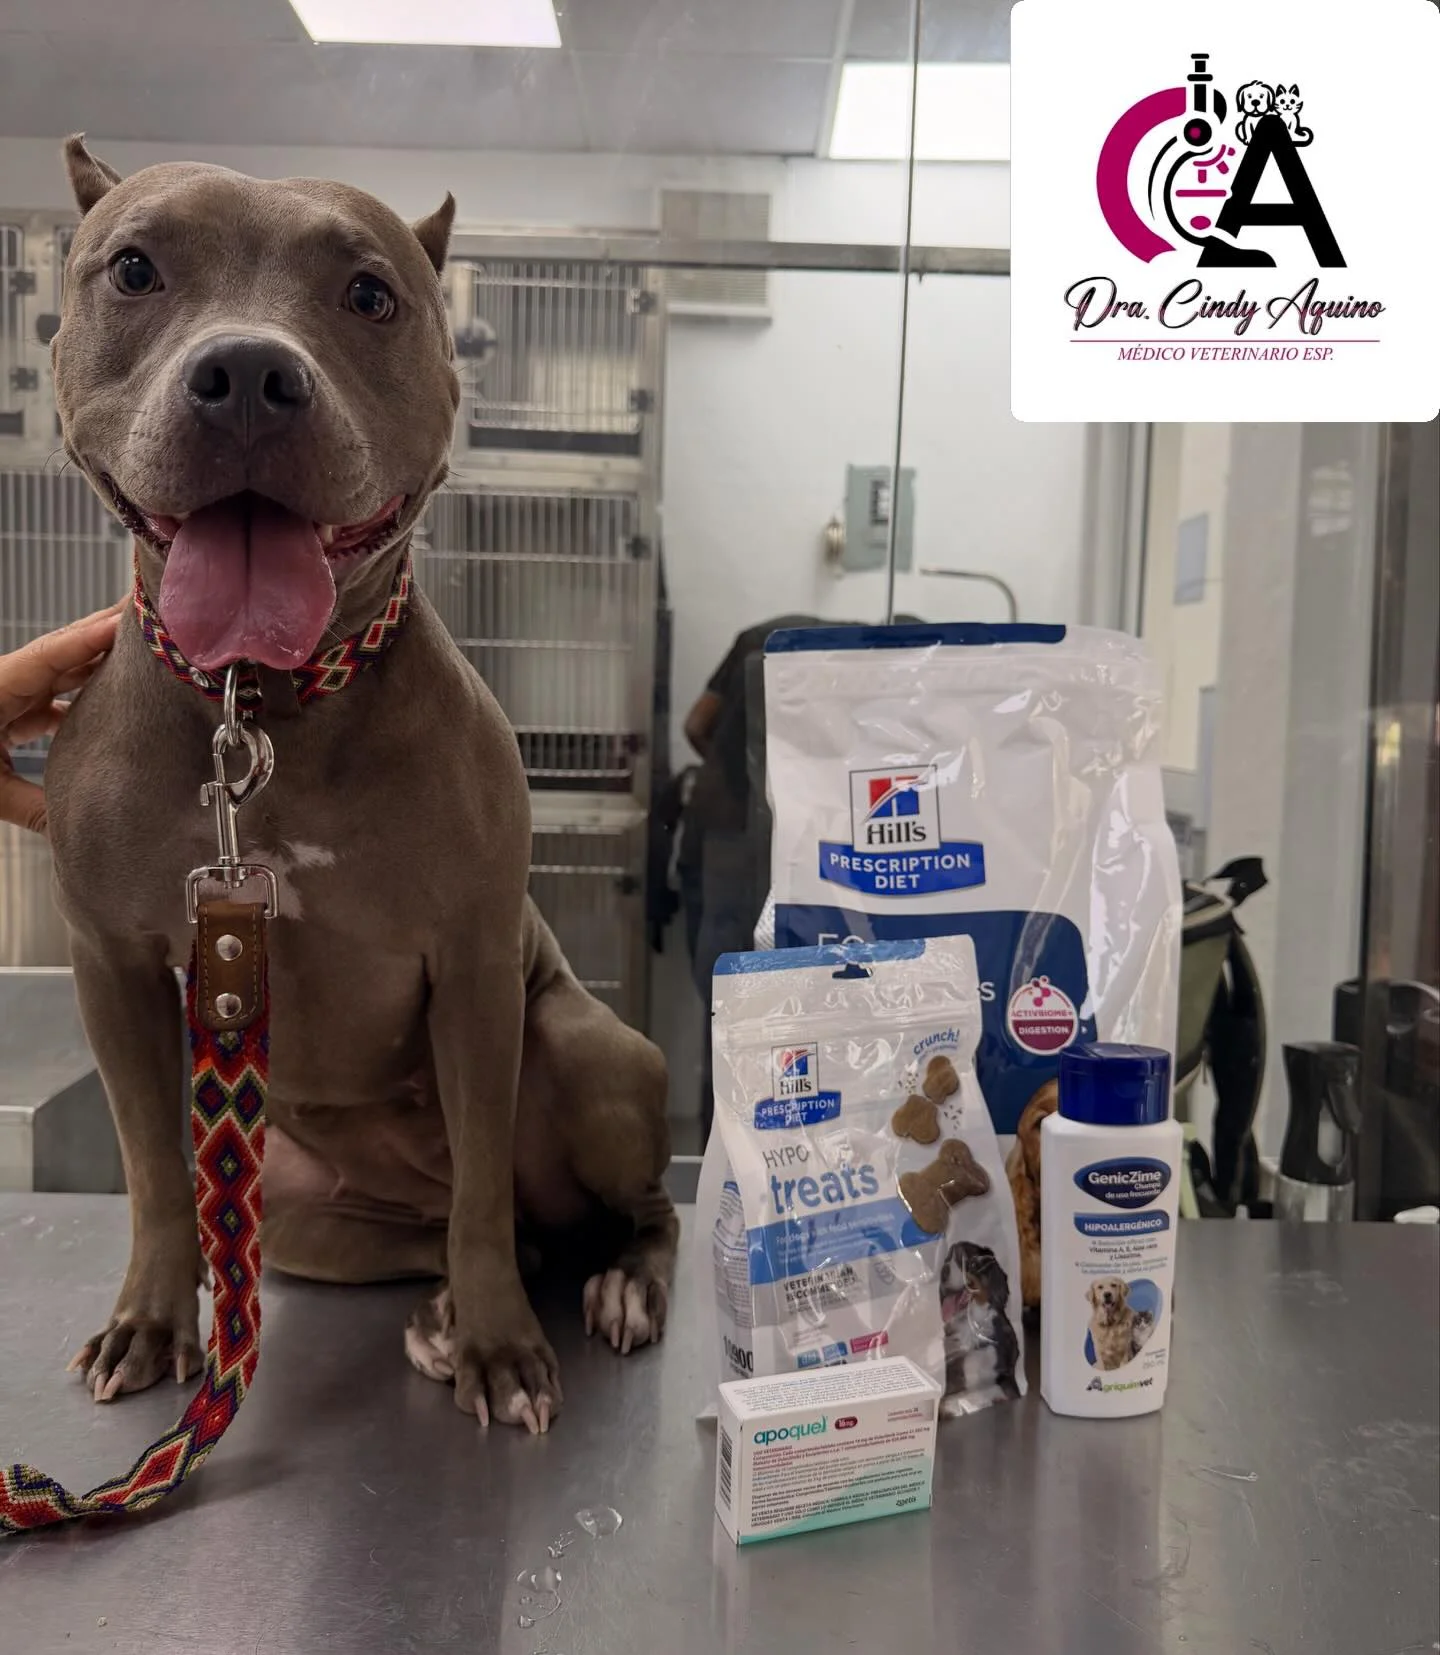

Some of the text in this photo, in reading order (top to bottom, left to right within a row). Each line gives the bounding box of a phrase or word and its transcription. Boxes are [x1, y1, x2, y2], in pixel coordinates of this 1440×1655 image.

[866, 821, 927, 845] Hill's
[830, 852, 971, 873] PRESCRIPTION
[874, 873, 921, 889] DIET
[1018, 1025, 1069, 1035] DIGESTION
[913, 1027, 960, 1055] crunch!
[780, 1078, 812, 1095] Hill's
[761, 1098, 835, 1117] PRESCRIPTION
[1087, 1170, 1162, 1185] GenicZime
[770, 1164, 880, 1215] treats
[1084, 1218, 1163, 1231] HIPOALERGÉNICO
[754, 1414, 827, 1446] apoquel
